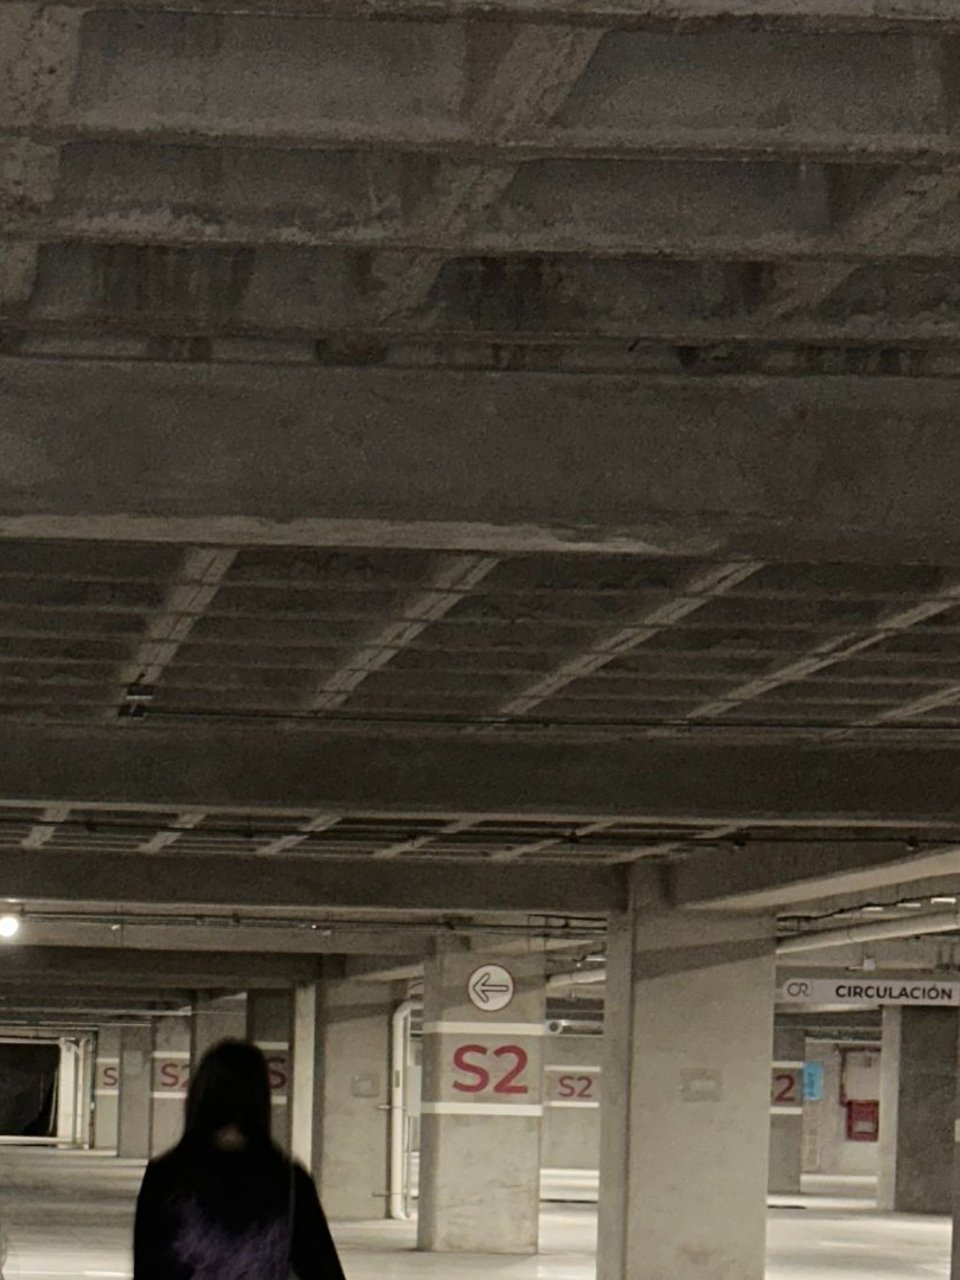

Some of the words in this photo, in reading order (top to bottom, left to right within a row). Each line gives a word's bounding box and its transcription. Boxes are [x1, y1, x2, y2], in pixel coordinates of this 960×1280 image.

[835, 984, 953, 1000] CIRCULACIÓN
[452, 1044, 528, 1094] S2
[558, 1075, 593, 1097] S2
[772, 1073, 795, 1102] 2
